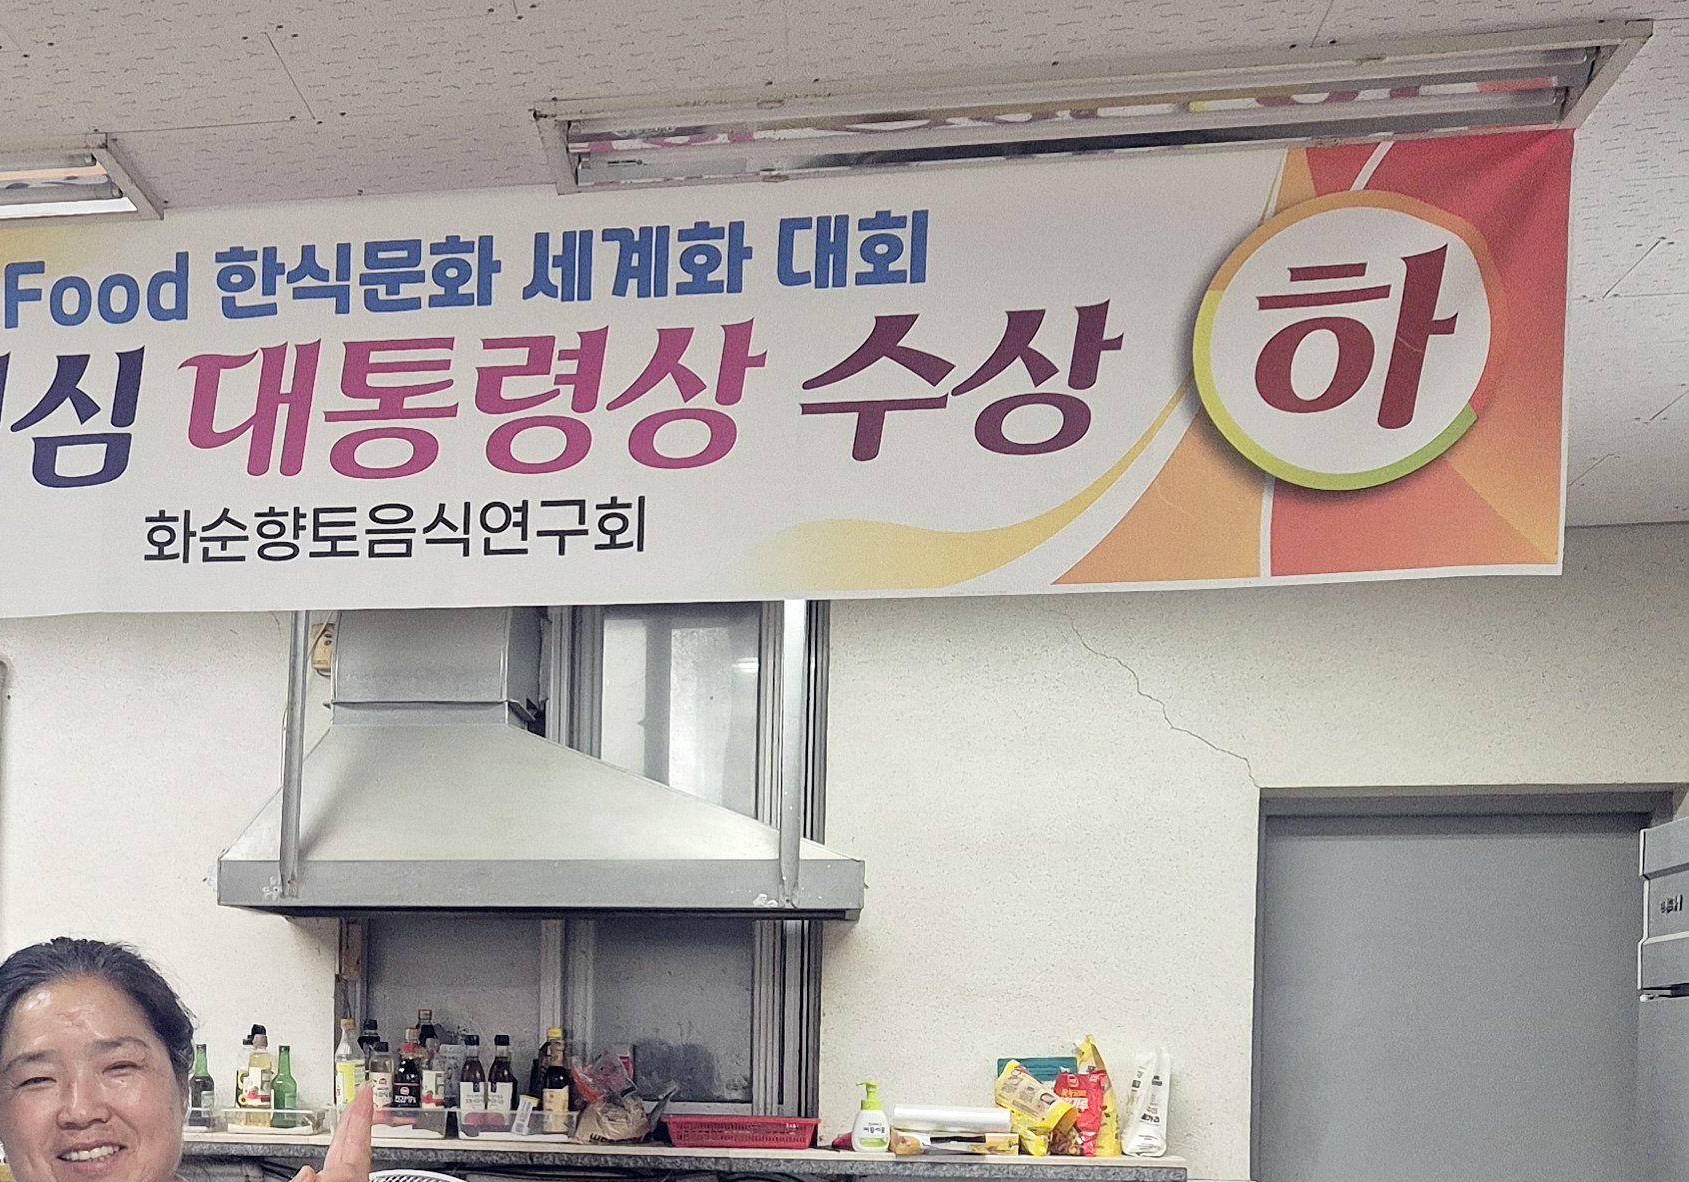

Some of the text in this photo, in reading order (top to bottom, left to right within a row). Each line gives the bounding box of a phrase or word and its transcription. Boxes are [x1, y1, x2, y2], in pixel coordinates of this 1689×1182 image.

[215, 235, 501, 317] 한식문화
[522, 218, 753, 304] 세계화
[776, 207, 930, 291] 대회
[177, 315, 768, 482] 대통령상
[800, 298, 1125, 463] 수상
[1253, 242, 1459, 431] 하
[143, 493, 648, 565] 화순향토음식연구회
